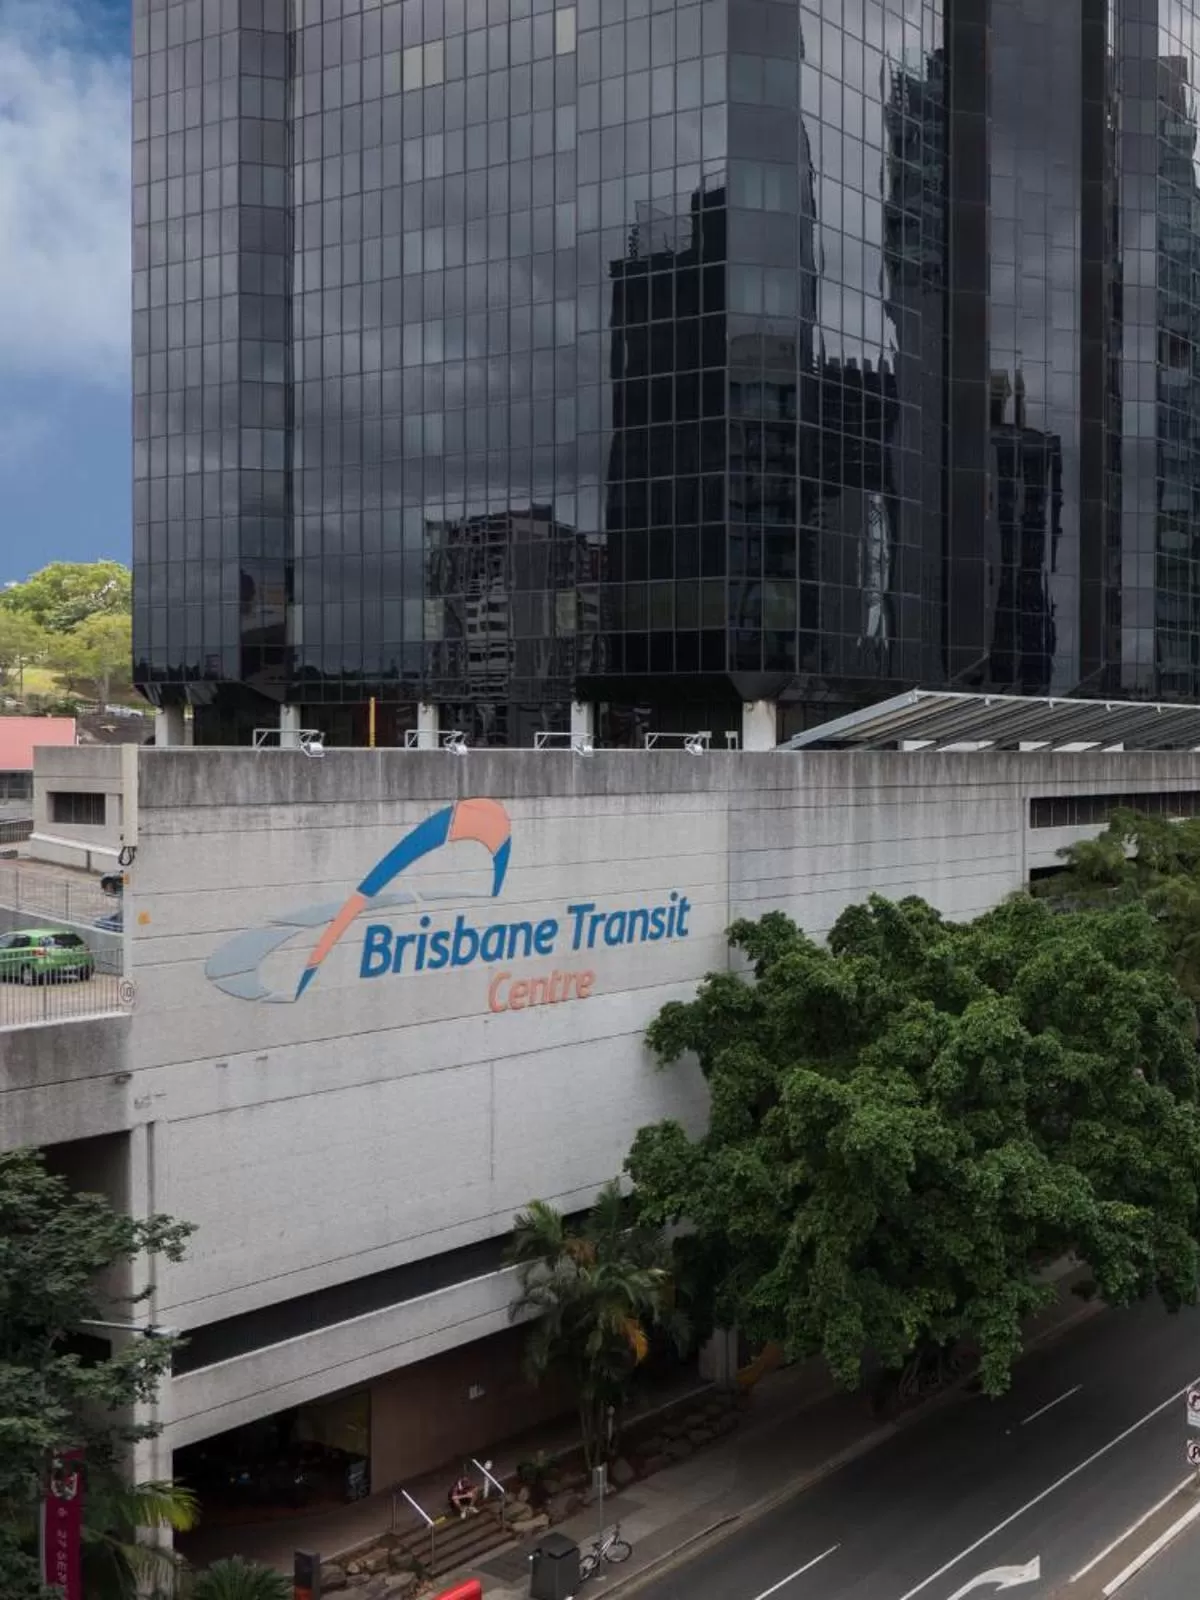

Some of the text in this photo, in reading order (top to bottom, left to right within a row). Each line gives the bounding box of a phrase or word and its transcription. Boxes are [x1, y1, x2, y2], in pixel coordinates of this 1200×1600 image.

[360, 892, 691, 978] Brisbane Transit
[488, 969, 594, 1013] Centre
